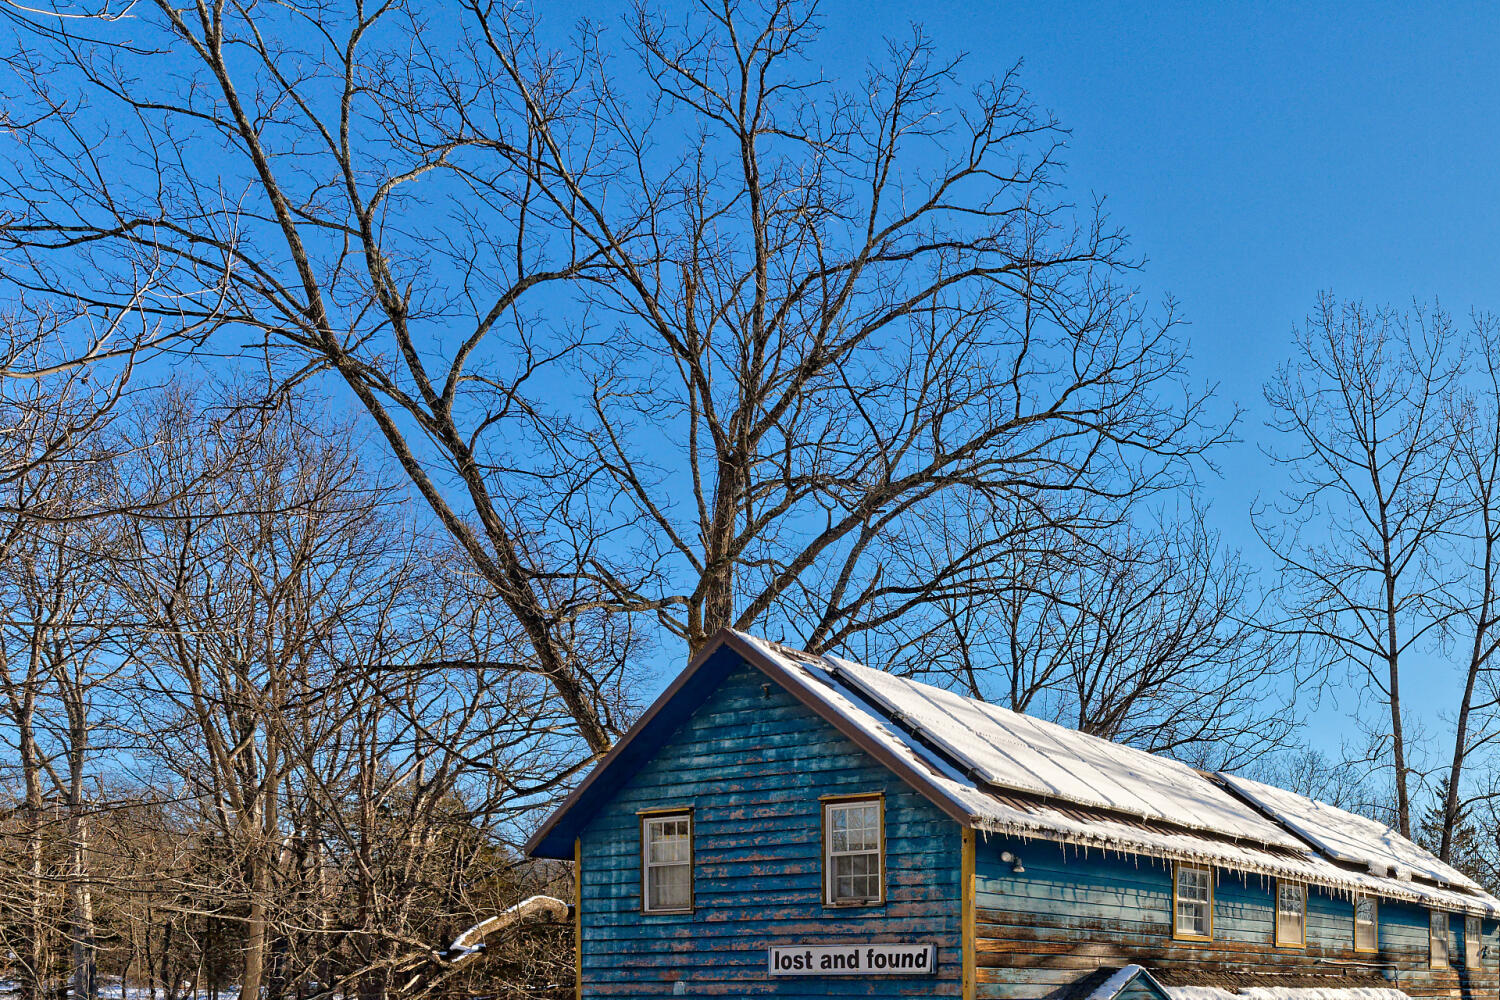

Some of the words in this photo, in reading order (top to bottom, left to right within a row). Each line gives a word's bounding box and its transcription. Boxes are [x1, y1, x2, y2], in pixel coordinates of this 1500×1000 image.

[774, 950, 813, 970] lost
[820, 949, 860, 970] and
[866, 947, 929, 969] found
